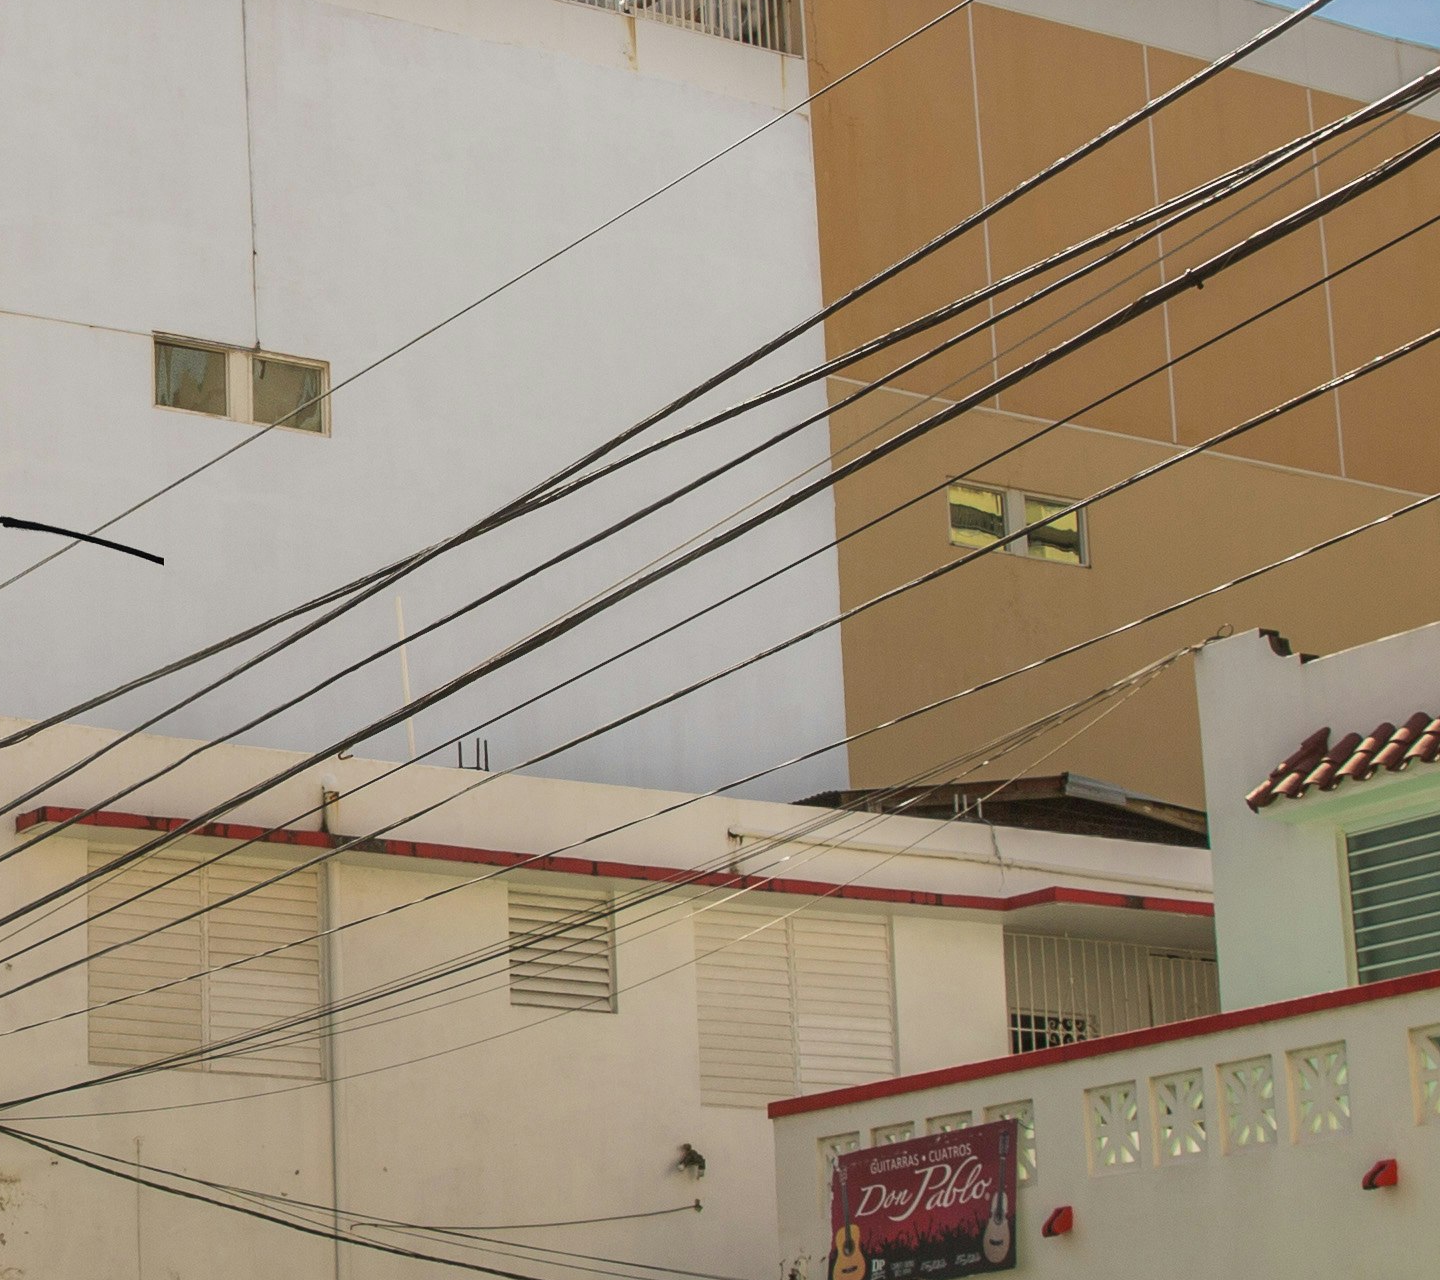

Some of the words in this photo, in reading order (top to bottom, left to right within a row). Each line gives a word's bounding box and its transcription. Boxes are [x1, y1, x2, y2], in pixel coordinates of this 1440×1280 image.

[871, 1155, 919, 1175] GUITARRAS
[928, 1144, 972, 1163] CUATROS
[855, 1184, 912, 1218] Don
